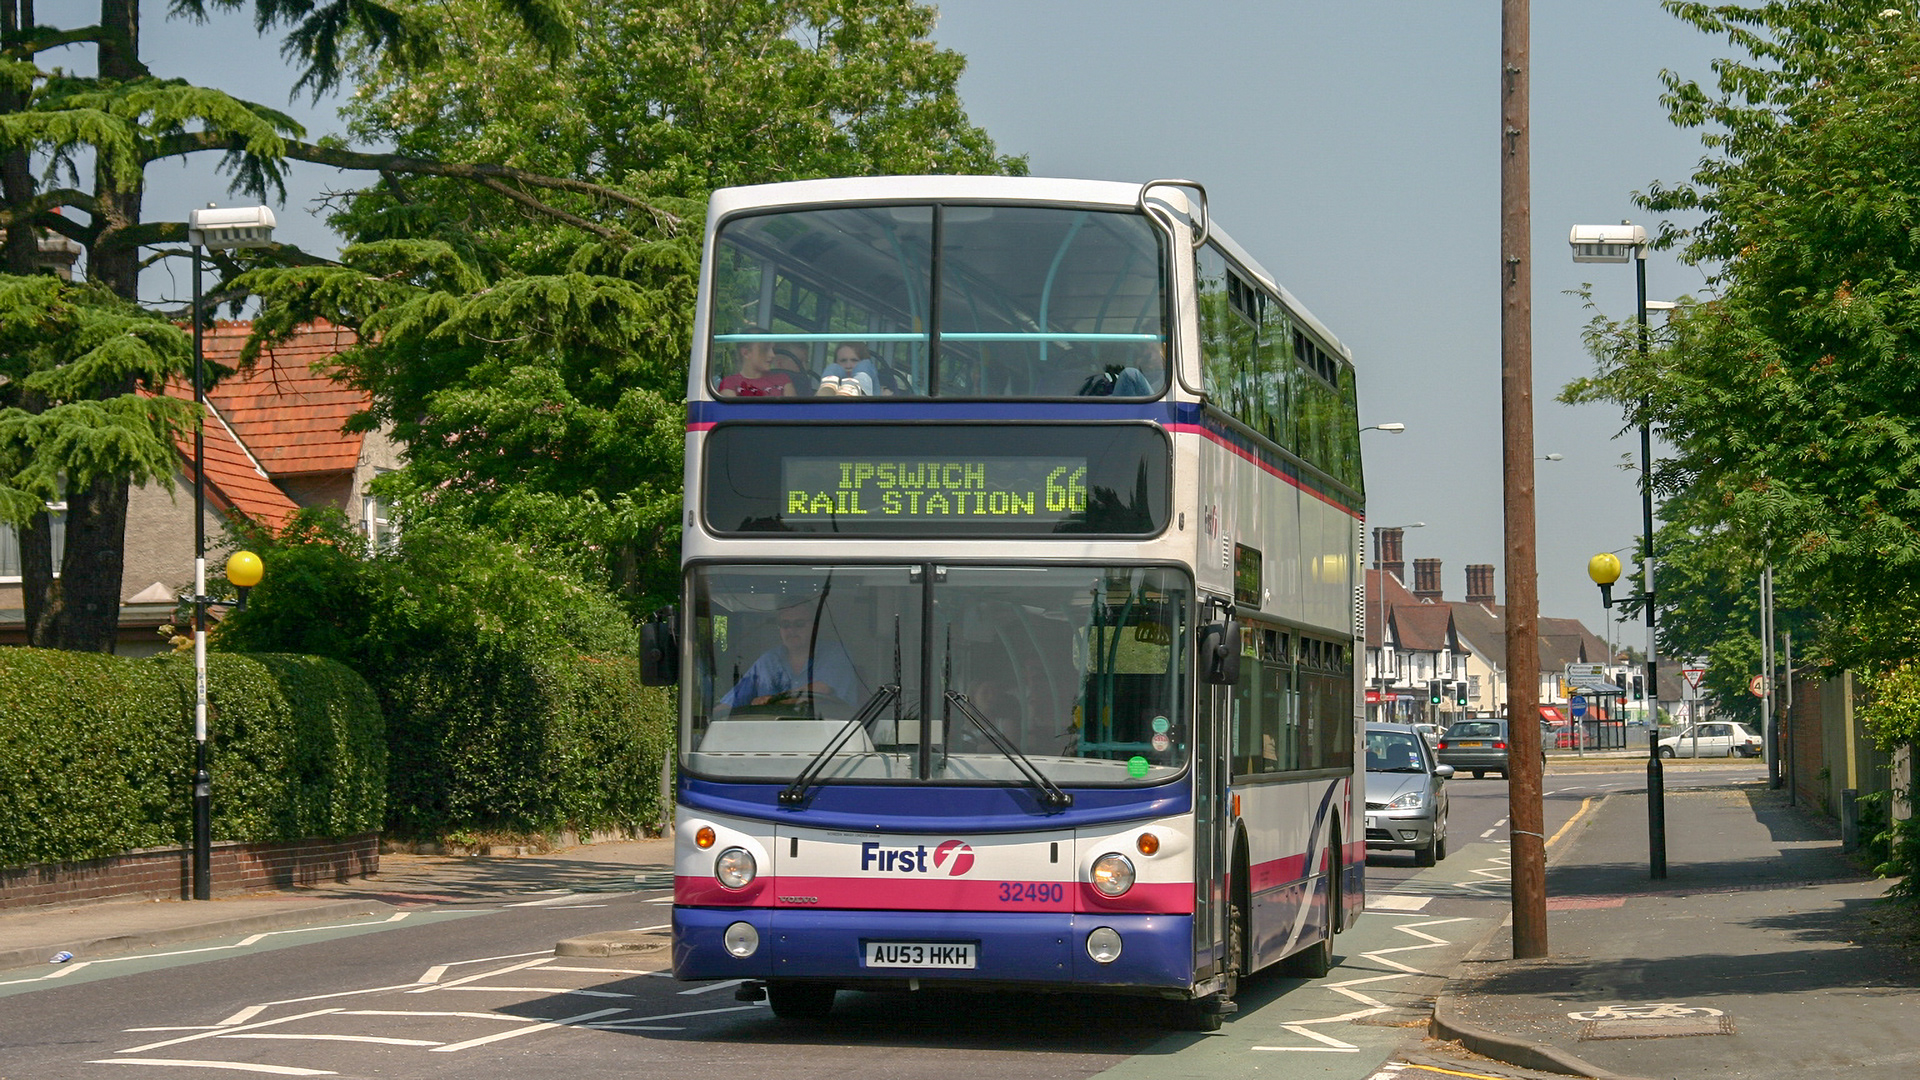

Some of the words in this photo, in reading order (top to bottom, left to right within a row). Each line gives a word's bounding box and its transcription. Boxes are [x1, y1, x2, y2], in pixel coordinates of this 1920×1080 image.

[839, 463, 985, 489] IPSWICH
[1046, 466, 1087, 512] 66
[788, 490, 867, 514] RAIL
[882, 491, 1035, 515] STATION
[861, 842, 927, 872] First
[777, 895, 818, 903] VOLVO
[999, 883, 1063, 903] 32490
[874, 946, 923, 964] AU53
[930, 947, 967, 965] HKH
